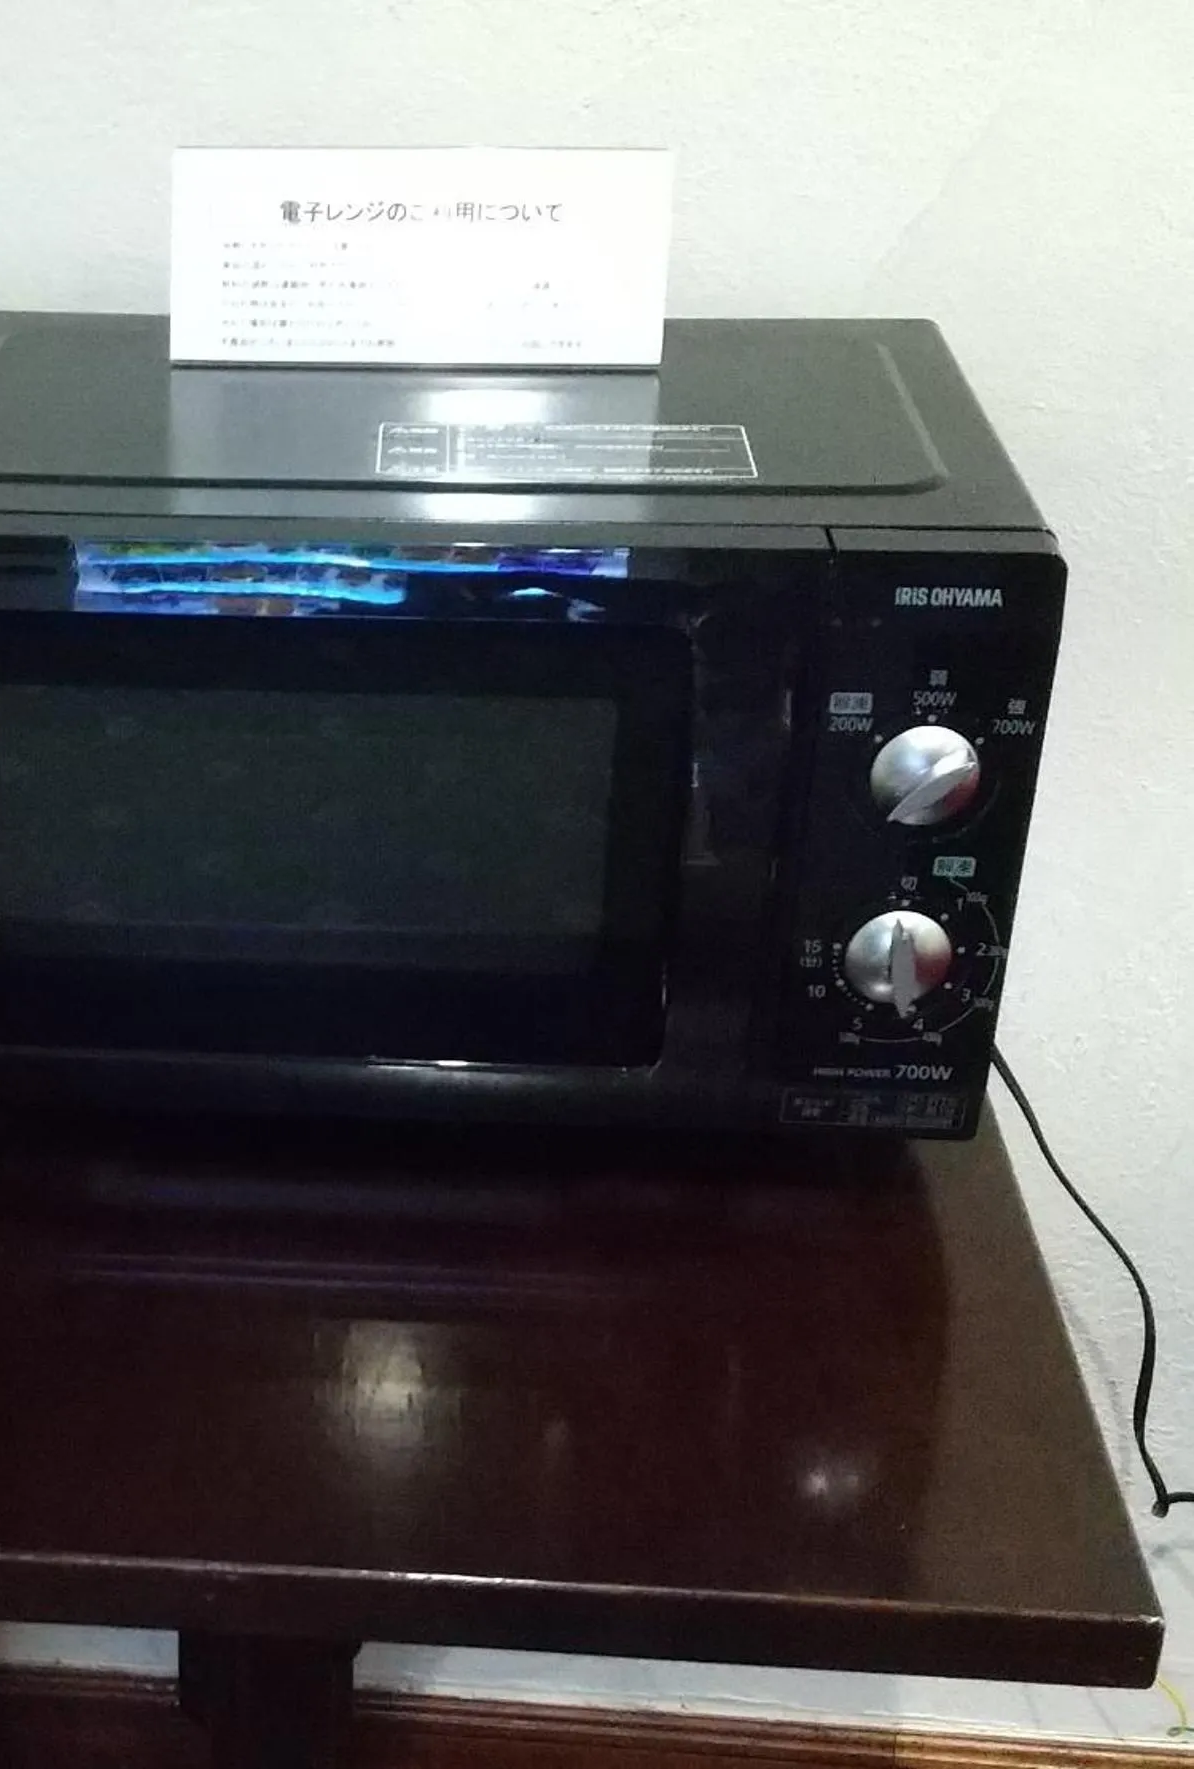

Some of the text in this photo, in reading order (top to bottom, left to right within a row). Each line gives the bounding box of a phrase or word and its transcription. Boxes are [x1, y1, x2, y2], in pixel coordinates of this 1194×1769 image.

[280, 200, 563, 223] 電子レンジのご用について
[932, 587, 1003, 607] OHYAMA
[913, 691, 957, 706] 500W
[829, 717, 873, 732] 200W
[993, 720, 1036, 735] 700W
[804, 939, 822, 953] 15
[807, 985, 826, 998] 10
[961, 988, 971, 1002] 3
[912, 1018, 924, 1031] 4
[895, 1065, 953, 1081] 700W
